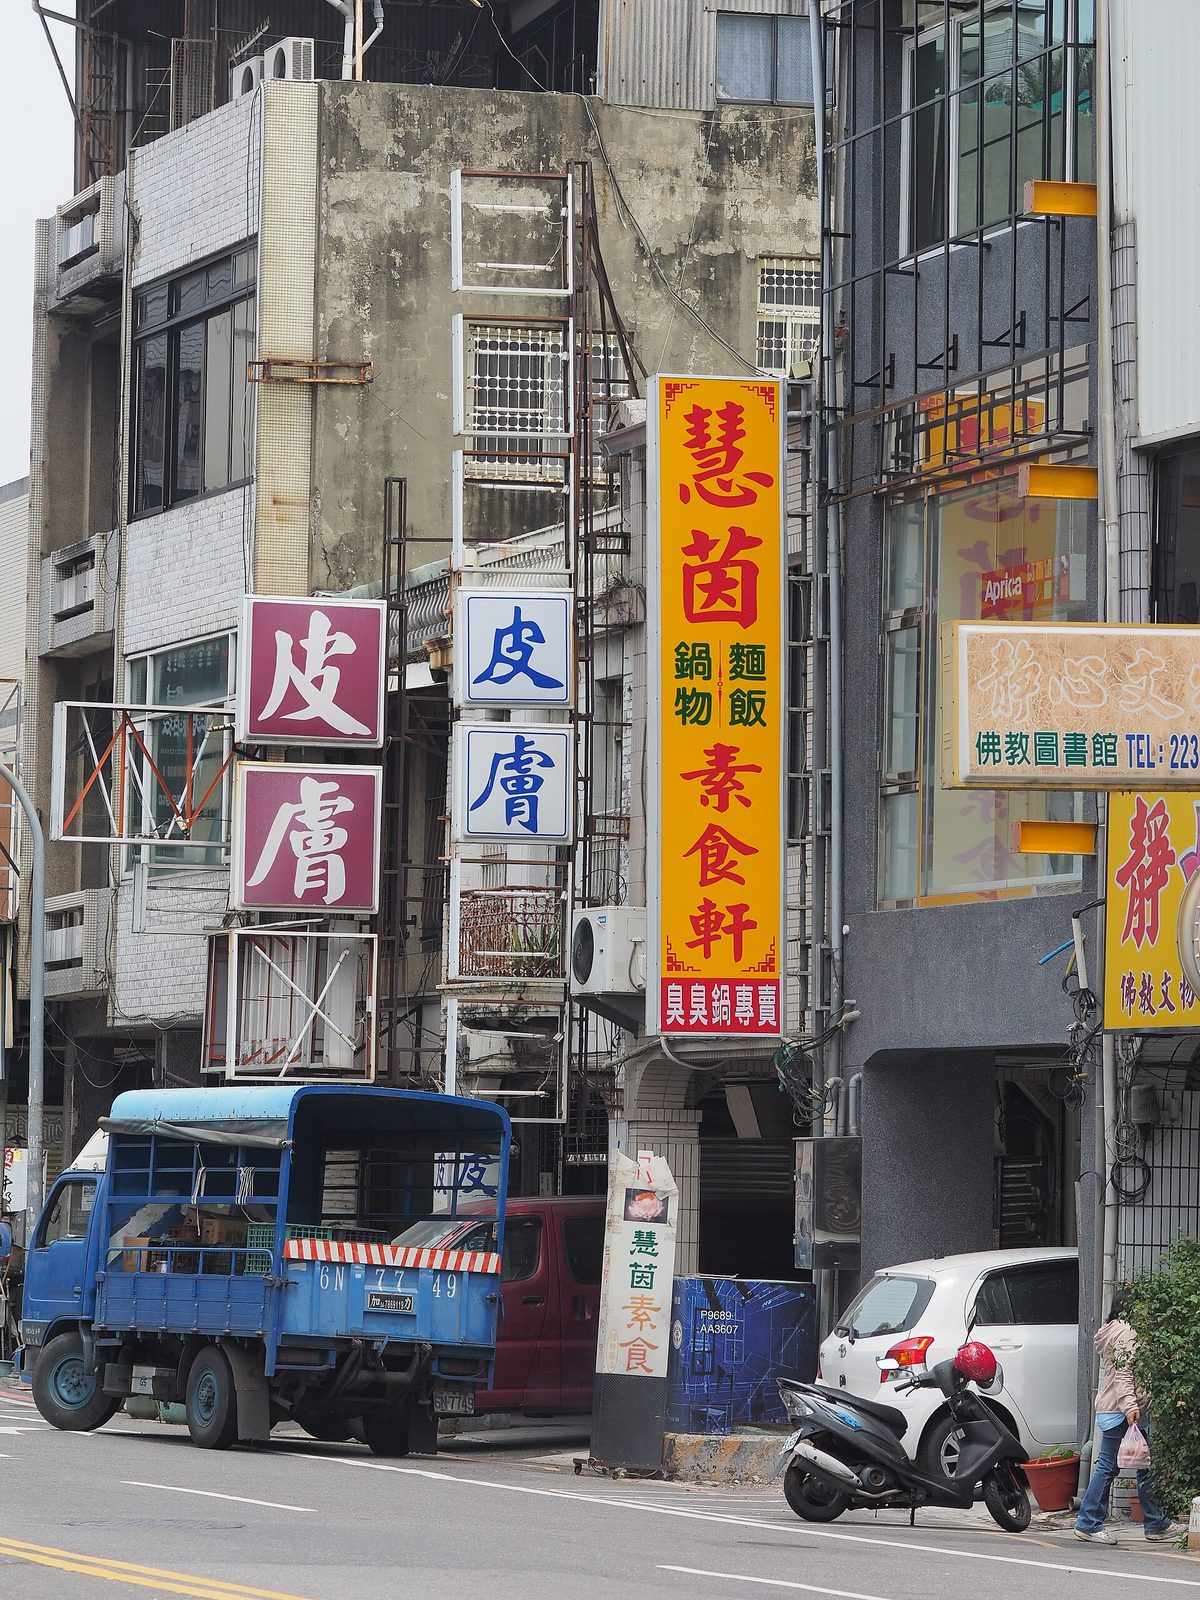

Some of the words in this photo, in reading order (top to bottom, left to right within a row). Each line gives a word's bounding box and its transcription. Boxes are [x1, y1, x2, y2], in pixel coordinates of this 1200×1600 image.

[679, 401, 774, 629] 慧茵
[984, 571, 1022, 605] Aprica
[674, 641, 712, 726] 鍋物
[729, 643, 767, 727] 麵飯
[978, 638, 1200, 723] 靜心文
[975, 731, 1118, 767] 佛教圖書館
[1125, 734, 1163, 768] TEL:
[680, 742, 762, 963] 素食軒
[1115, 796, 1200, 949] 靜
[666, 982, 777, 1027] 臭臭鍋專賣
[320, 1265, 345, 1291] 6N
[375, 1268, 405, 1292] 77
[432, 1274, 457, 1298] 49
